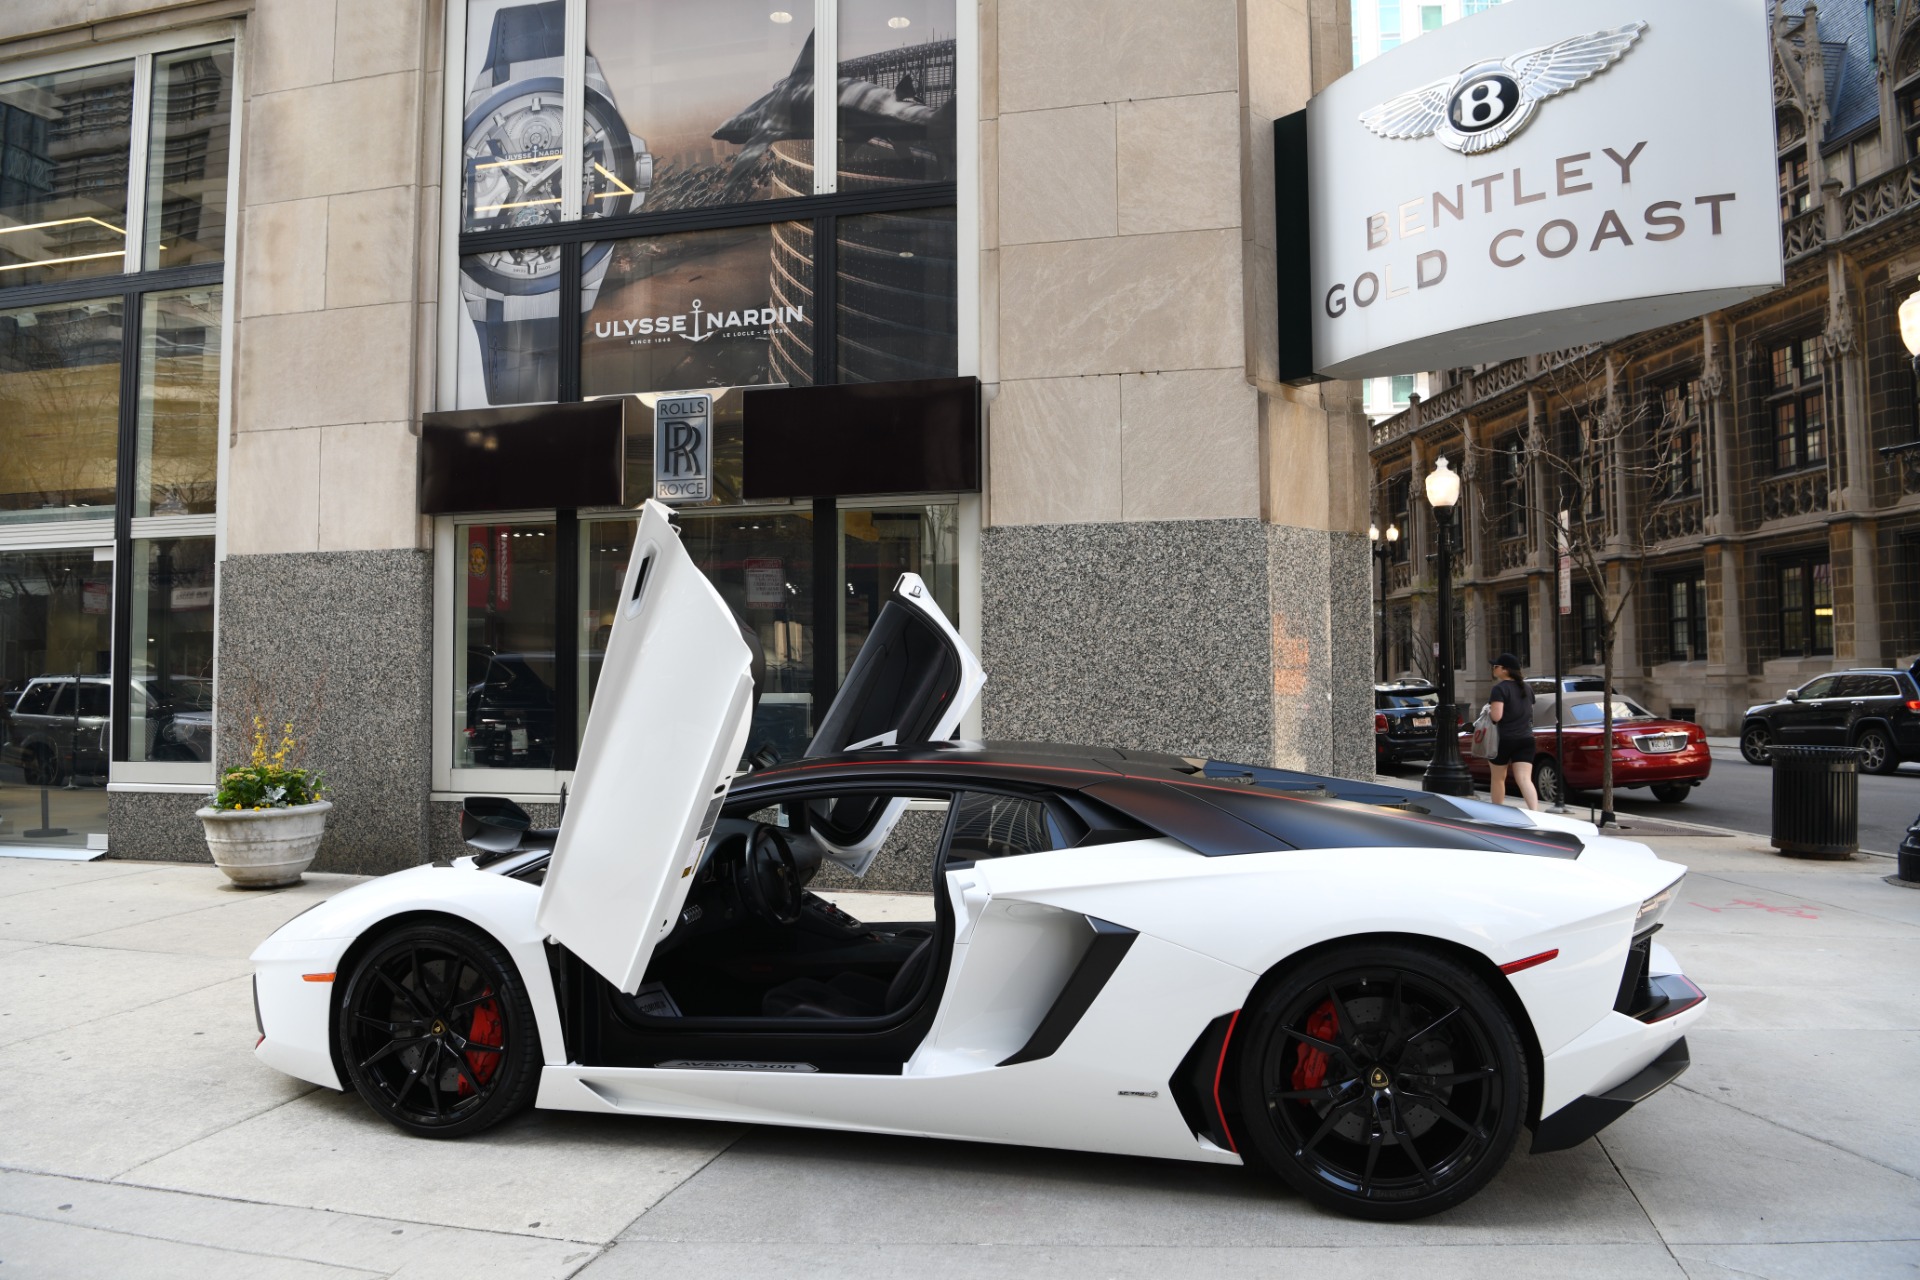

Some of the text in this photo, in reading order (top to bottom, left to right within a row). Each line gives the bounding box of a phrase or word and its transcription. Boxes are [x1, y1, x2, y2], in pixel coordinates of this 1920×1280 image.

[505, 148, 562, 160] ULYSSE NARDI
[1366, 141, 1648, 251] BENTLEY
[1325, 193, 1736, 319] GOLD COAST
[595, 306, 803, 338] ULYSSE NARDIN
[660, 401, 704, 415] ROLLS
[660, 482, 704, 496] ROYCE
[678, 1061, 798, 1070] AVENTADOR
